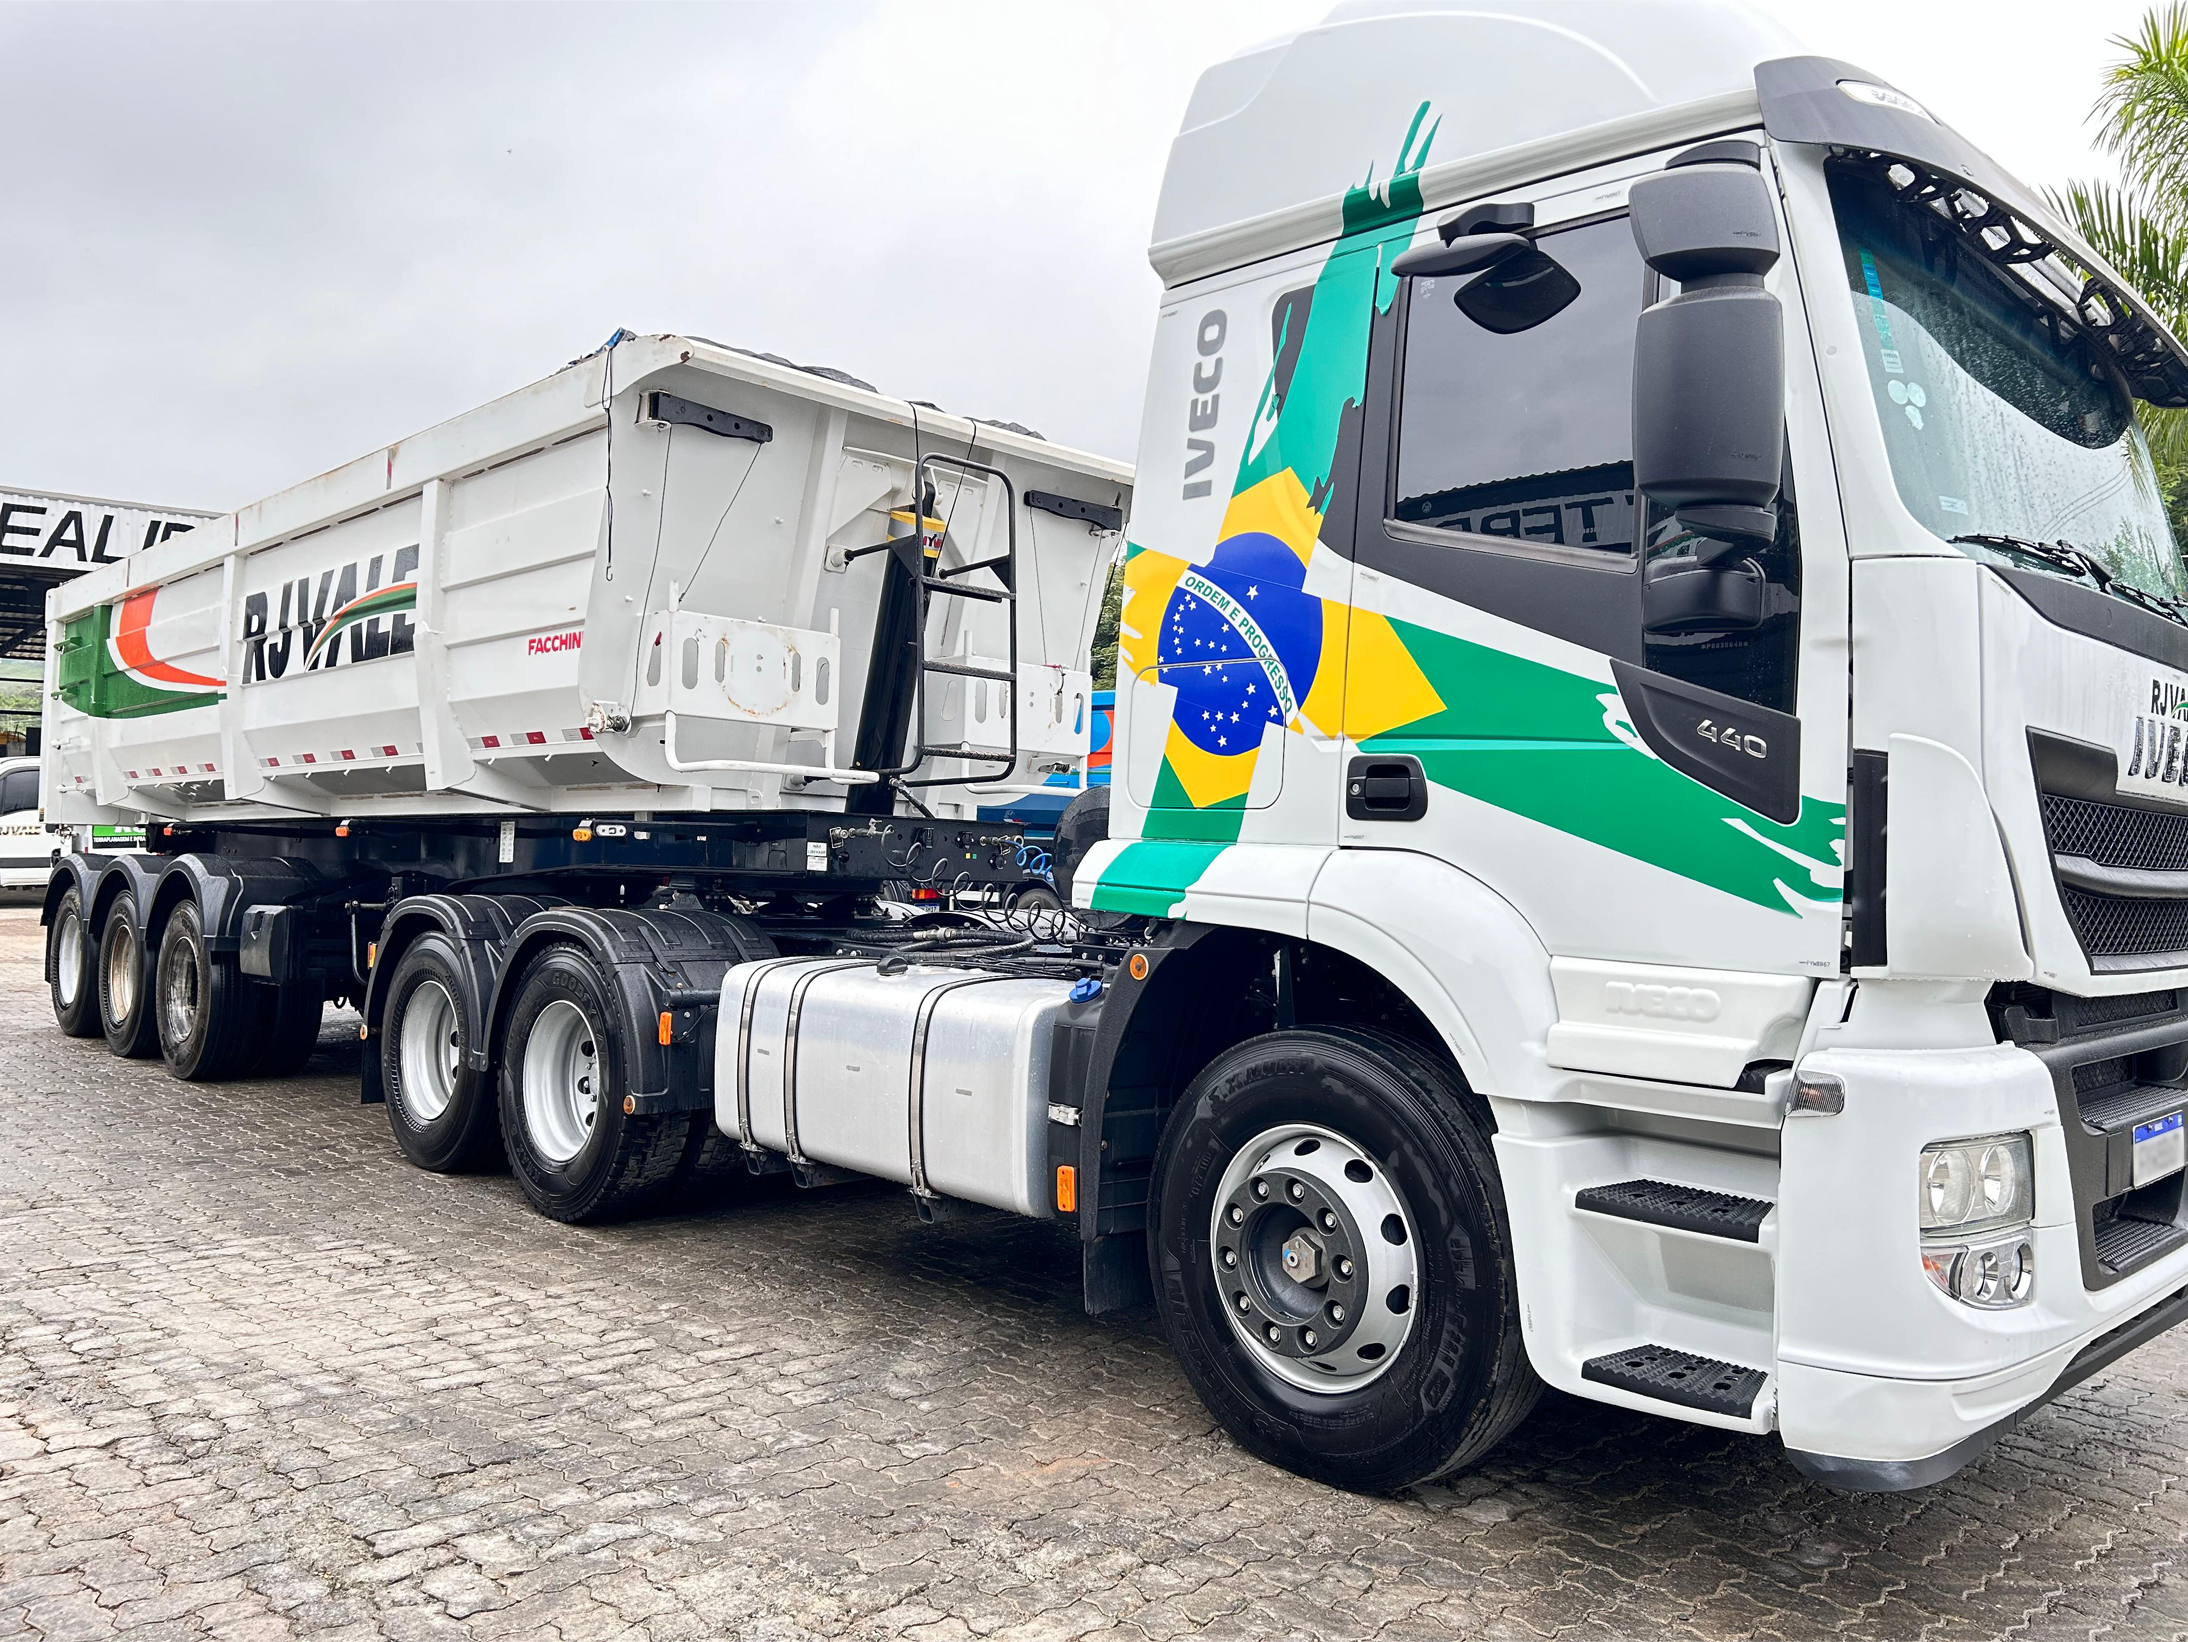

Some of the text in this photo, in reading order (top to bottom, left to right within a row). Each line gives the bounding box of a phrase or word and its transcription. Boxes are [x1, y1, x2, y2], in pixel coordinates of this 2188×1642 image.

[1182, 309, 1227, 501] IVECO
[242, 543, 420, 684] RJVALE
[1185, 576, 1293, 713] ORDEM E PROGRESSO
[1697, 719, 1767, 759] 440
[1605, 980, 1721, 1024] IVECO
